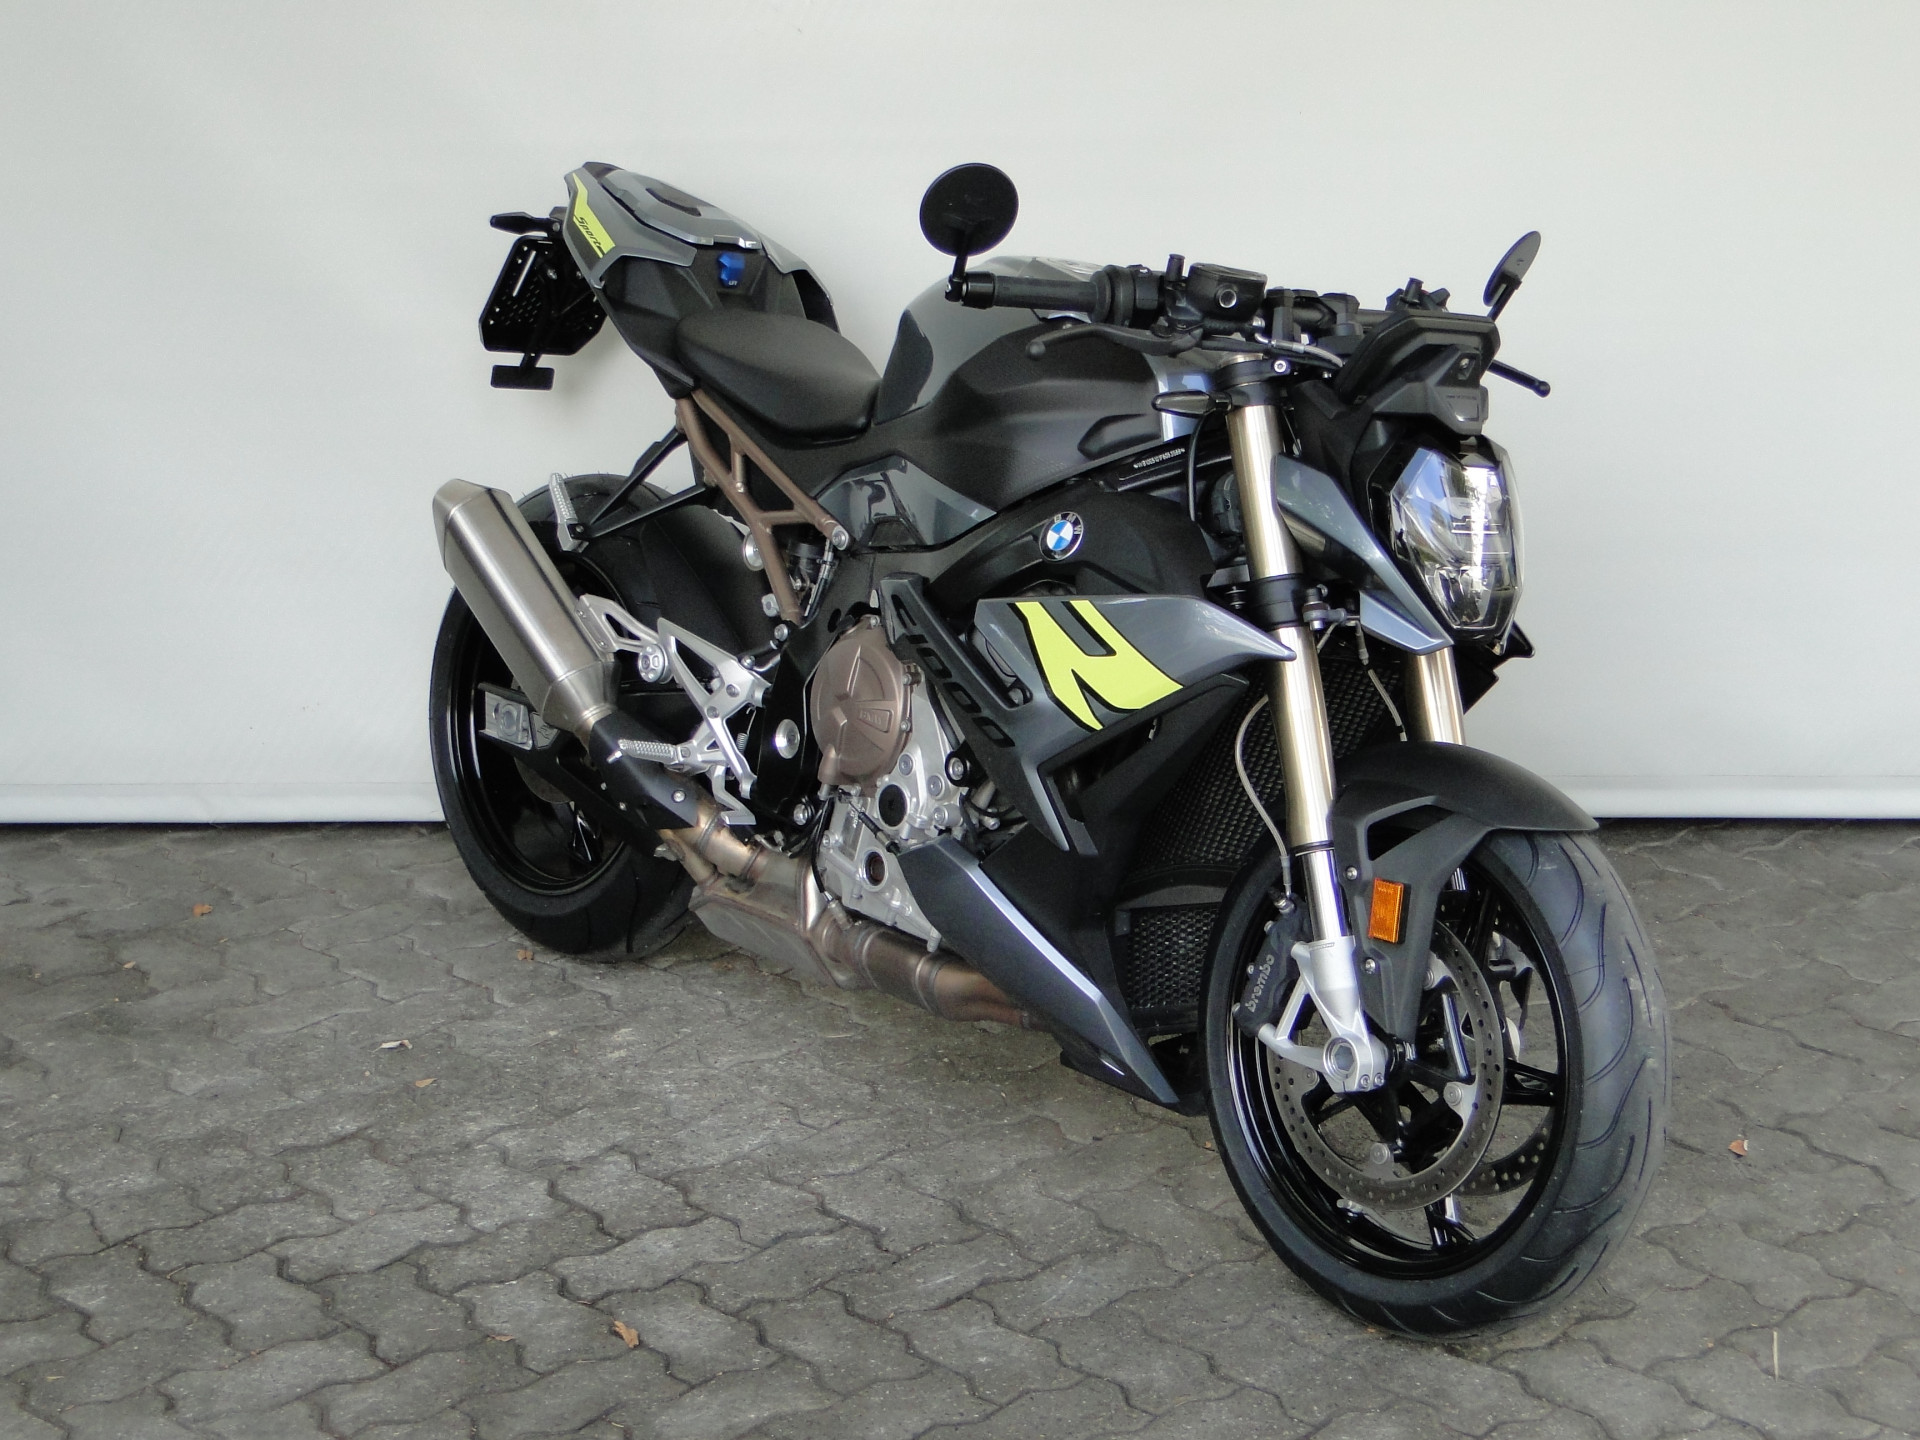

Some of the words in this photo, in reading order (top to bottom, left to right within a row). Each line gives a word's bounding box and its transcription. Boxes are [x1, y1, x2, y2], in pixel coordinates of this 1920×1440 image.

[576, 216, 602, 247] Sport
[1053, 513, 1083, 535] BMW
[1244, 954, 1275, 1013] brembo
